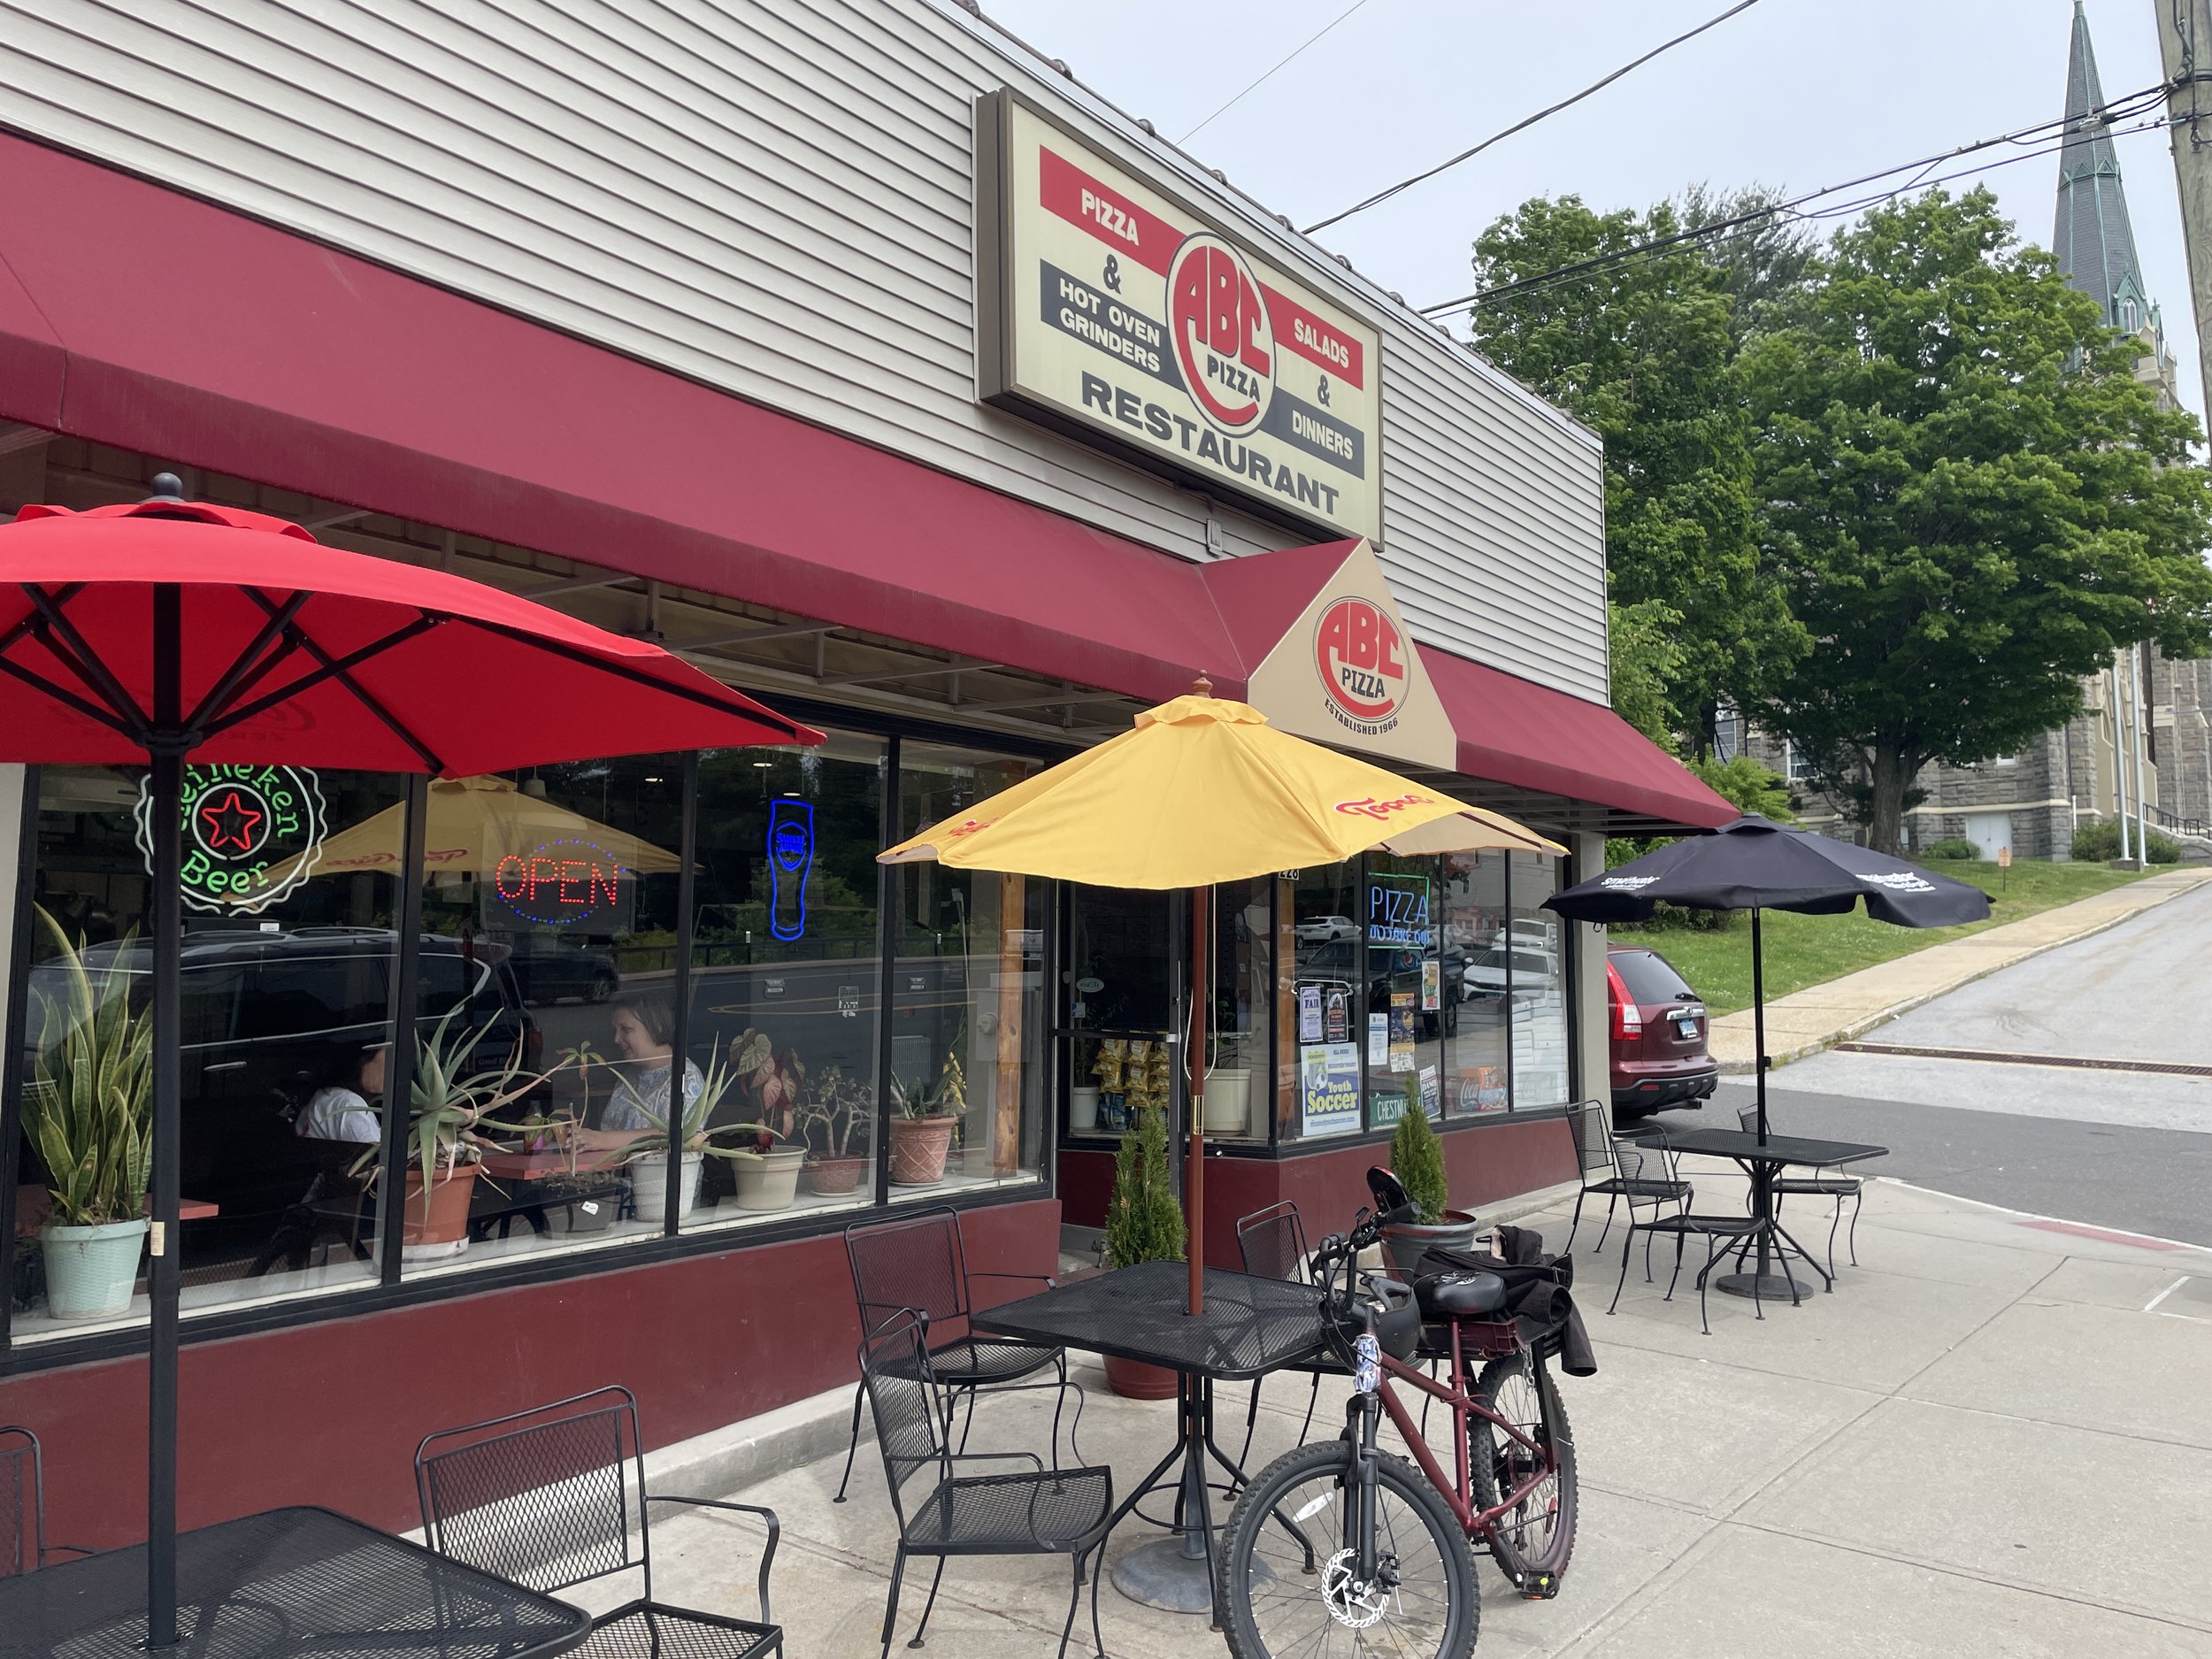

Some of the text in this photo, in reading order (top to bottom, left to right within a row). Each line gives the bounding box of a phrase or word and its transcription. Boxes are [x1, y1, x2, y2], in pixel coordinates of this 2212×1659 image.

[1081, 188, 1140, 247] PIZZA
[1102, 254, 1121, 295] &
[1060, 278, 1161, 348] HOT OVEN
[1172, 245, 1270, 379] ABC
[1060, 307, 1161, 373] GRINDERS
[1294, 319, 1349, 369] SALADS
[1207, 355, 1261, 402] PIZZA
[1317, 374, 1331, 407] &
[1081, 371, 1340, 516] RESTAURANT
[1292, 410, 1353, 460] DINNERS
[1317, 602, 1403, 680] ABC
[1341, 666, 1386, 698] PIZZA
[1324, 699, 1398, 735] ESTABLISHED 1966
[180, 764, 299, 837] eineken
[180, 849, 269, 894] Beer
[495, 854, 618, 906] OPEN
[1371, 886, 1430, 926] PIZZA
[1308, 1092, 1357, 1113] Soccer
[1328, 1080, 1352, 1094] Youth
[1378, 1097, 1409, 1121] CHESTNU
